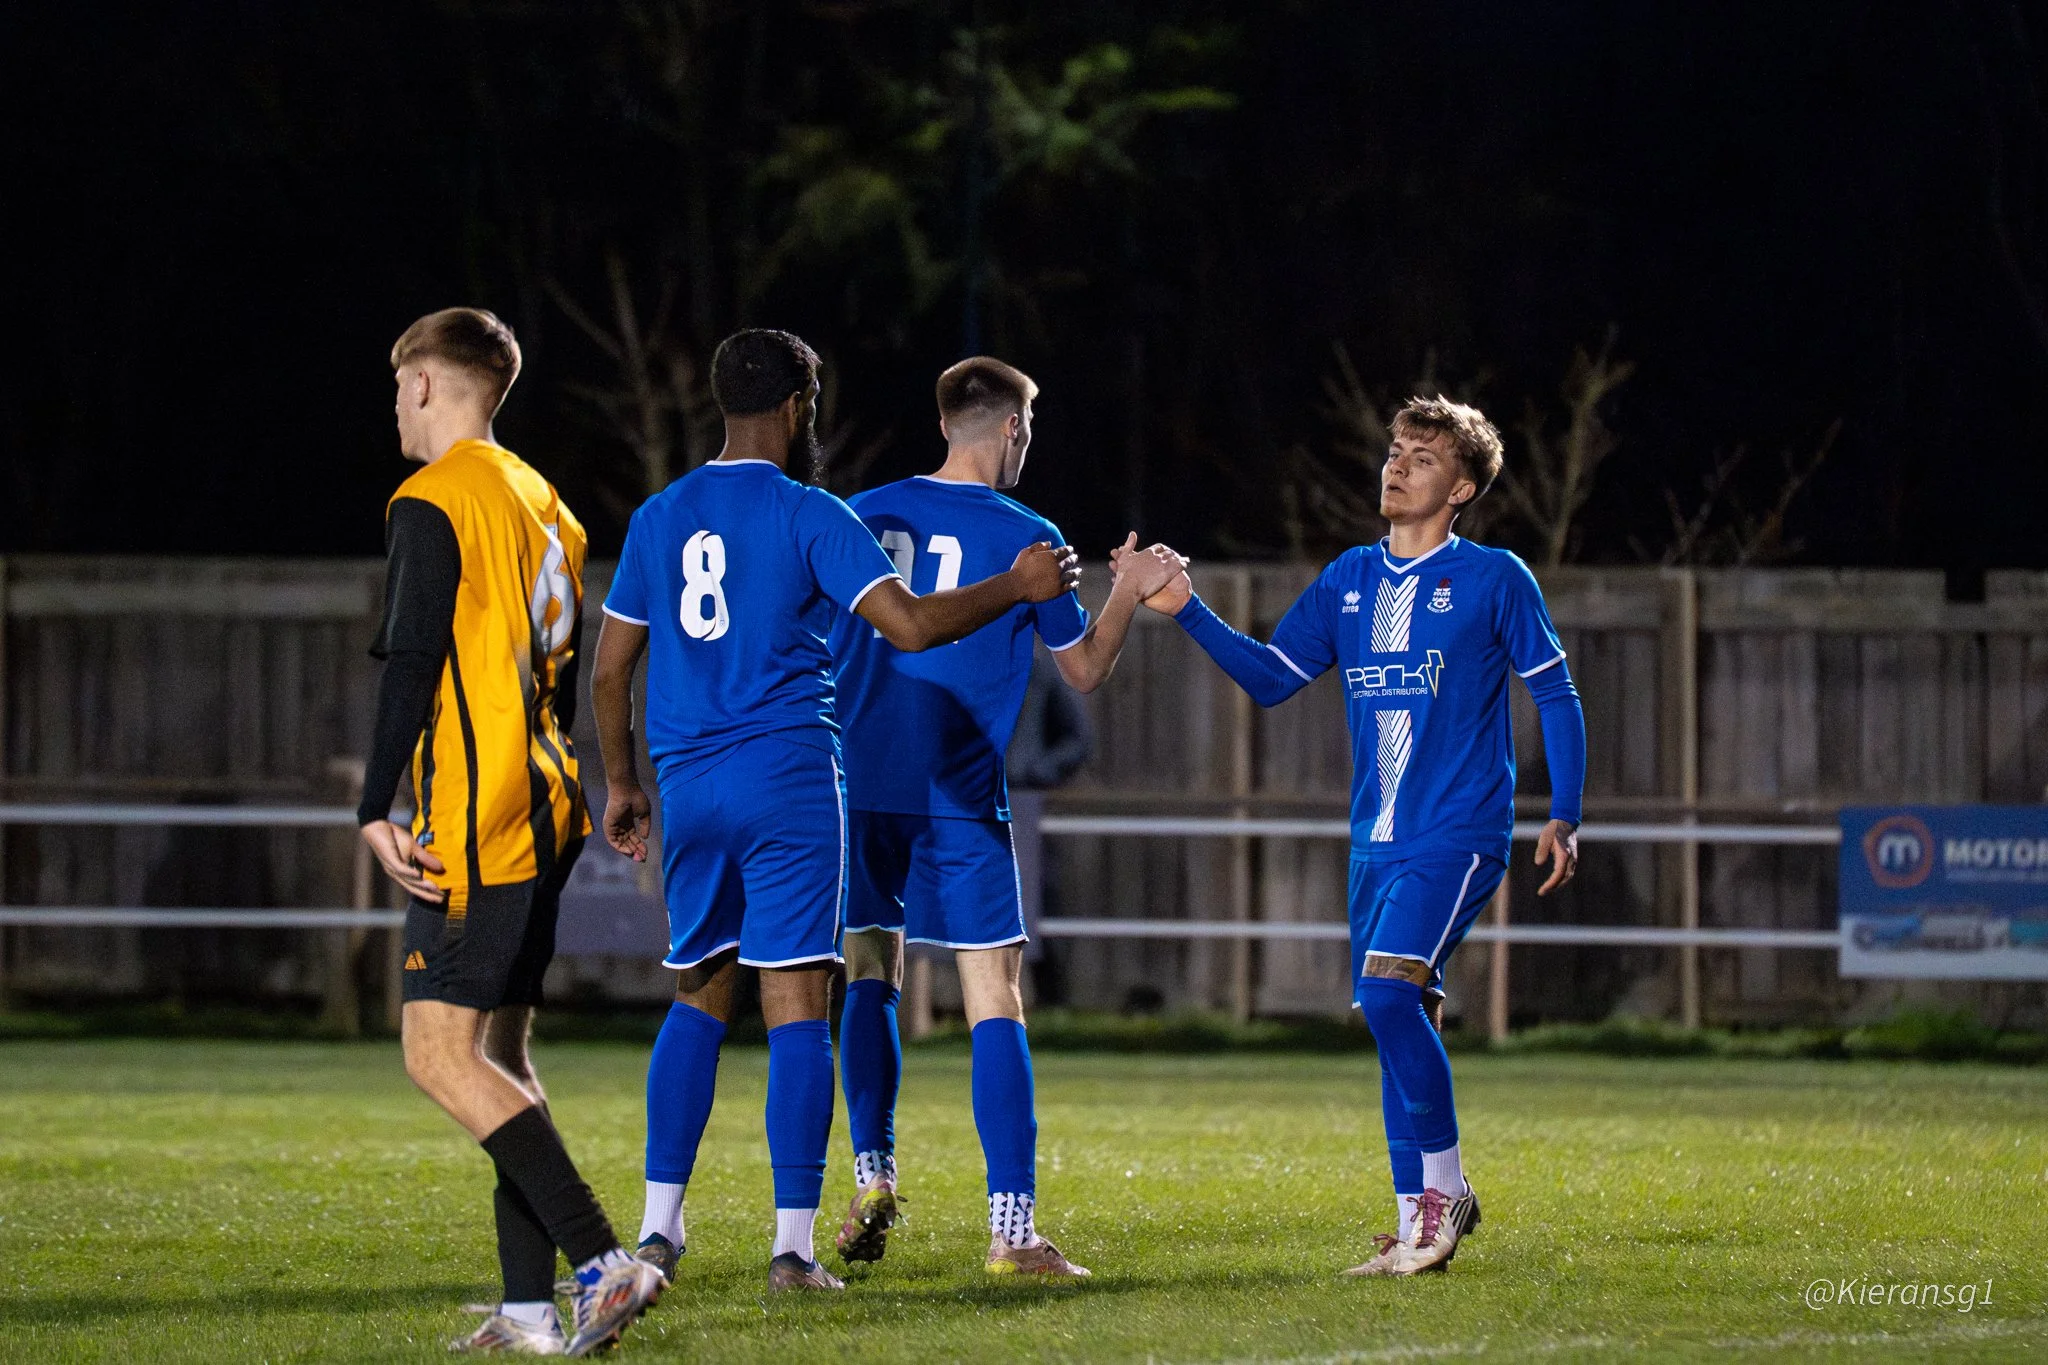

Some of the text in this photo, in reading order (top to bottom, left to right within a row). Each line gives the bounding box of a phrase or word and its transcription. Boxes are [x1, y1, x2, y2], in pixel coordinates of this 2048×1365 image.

[531, 523, 576, 657] 6
[679, 530, 730, 641] 8
[1381, 687, 1428, 696] DISTRIBUTORS
